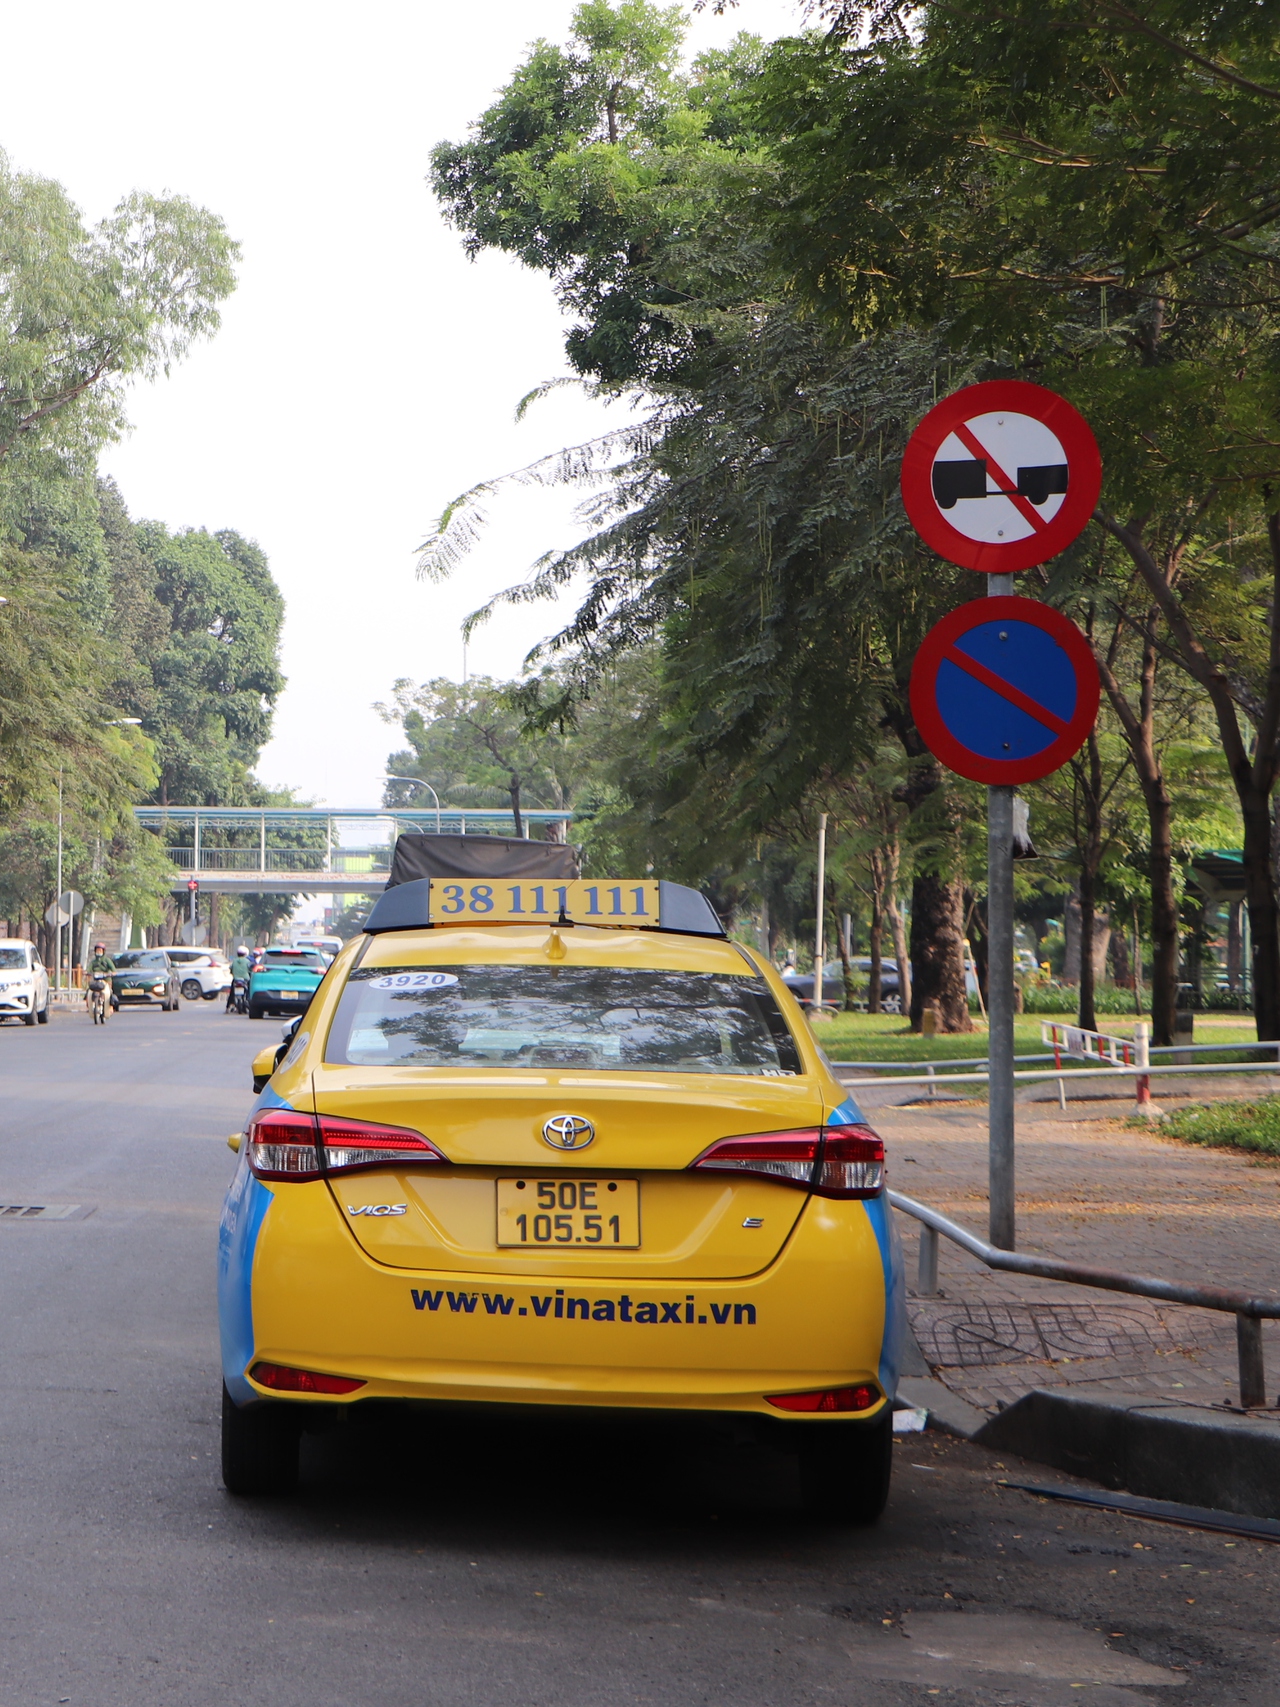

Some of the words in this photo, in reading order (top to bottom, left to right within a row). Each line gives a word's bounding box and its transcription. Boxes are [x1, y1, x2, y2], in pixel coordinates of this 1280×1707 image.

[441, 885, 494, 914] 38
[507, 885, 571, 914] 111
[584, 886, 649, 915] 111
[379, 974, 446, 988] 3920
[347, 1204, 408, 1216] VIOS
[537, 1181, 598, 1210] 50E
[516, 1214, 620, 1243] 105.51
[410, 1289, 757, 1325] www.vinataxi.vn
